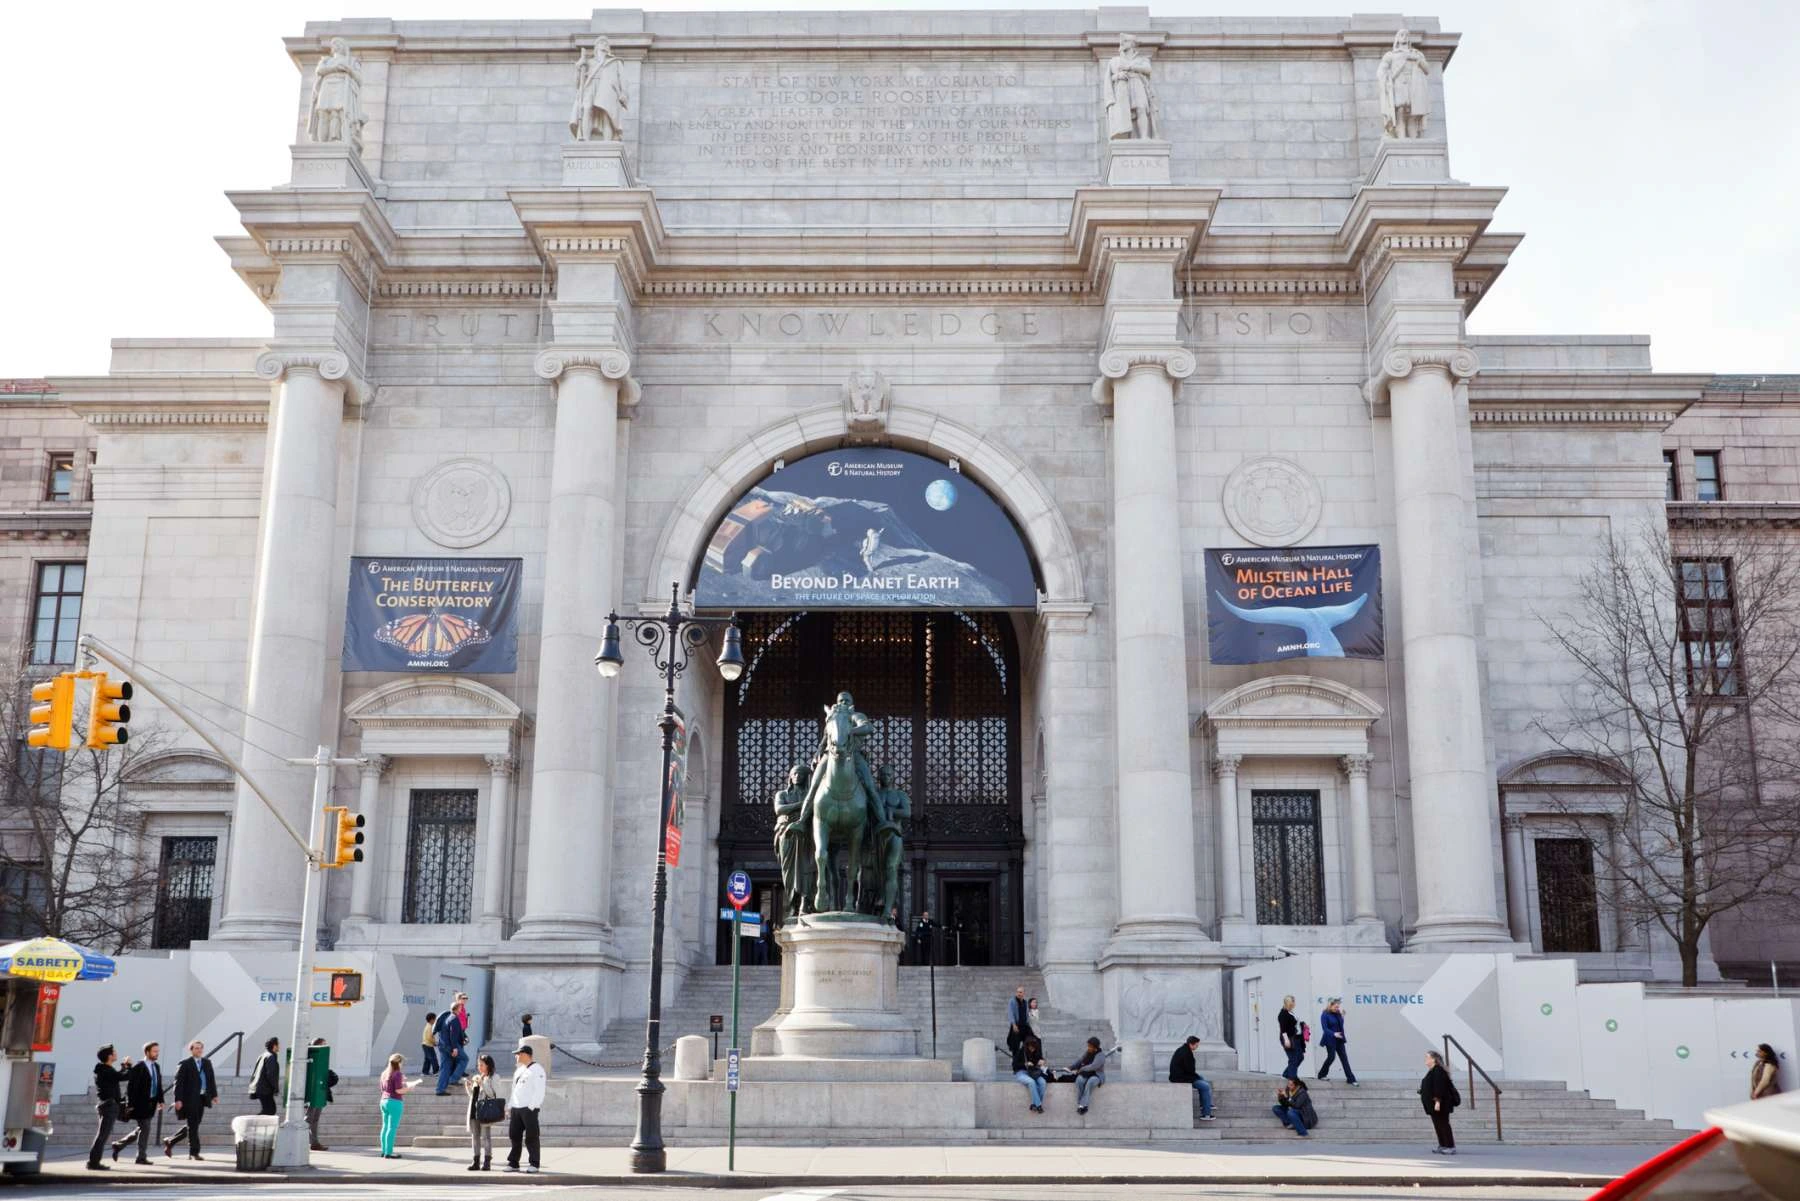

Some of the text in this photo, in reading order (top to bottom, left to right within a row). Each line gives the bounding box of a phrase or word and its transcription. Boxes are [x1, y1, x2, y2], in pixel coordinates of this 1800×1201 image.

[722, 76, 1017, 89] STATE OF NEW YORK MEMORIAL TO
[756, 91, 982, 104] THEODORE ROOSEVELT
[858, 107, 885, 118] THE
[894, 107, 941, 118] YOUTH
[950, 107, 967, 118] OF
[975, 107, 1038, 118] AMERICA
[669, 120, 682, 130] IN
[688, 120, 739, 130] ENERGY
[744, 120, 774, 130] AND
[862, 120, 875, 130] IN
[883, 120, 905, 130] THE
[912, 120, 950, 130] FAITH
[956, 120, 974, 130] OF
[980, 120, 1010, 130] OUR
[1015, 120, 1071, 130] FATHERS
[711, 132, 1027, 143] IN DEFENSE OF THE RIGHTS OF THE PEOPLE
[699, 145, 713, 156] IN
[755, 145, 791, 156] LOVE
[800, 145, 829, 156] AND
[724, 158, 1014, 169] AND OF THE BEST IN LIFE AND IN MAN
[703, 312, 1040, 336] KNOWLEDGE
[1179, 312, 1348, 336] VISION
[844, 462, 904, 470] AMERICAN MUSEUM
[1236, 555, 1270, 564] AMERICAN
[1271, 555, 1300, 563] MUSEUM
[1306, 554, 1336, 562] NATURAL
[1336, 553, 1363, 561] HISTORY
[382, 565, 416, 573] AMERICAN
[450, 565, 478, 573] NATURAL
[479, 566, 506, 574] HISTORY
[1236, 567, 1353, 584] MILSTEIN HALL
[381, 577, 494, 593] THE BUTTERFLY
[771, 574, 960, 589] BEYOND PLANET EARTH
[795, 592, 810, 601] THE
[812, 592, 843, 601] FUTURE
[856, 592, 880, 601] SPACE
[881, 592, 936, 601] EXPLORATION
[1238, 582, 1353, 600] OF OCEAN LIFE
[376, 593, 493, 608] CONSERVATORY
[1277, 642, 1321, 653] AMNH.ORG
[16, 957, 80, 968] SABRETT
[1355, 994, 1424, 1005] ENTRANCE
